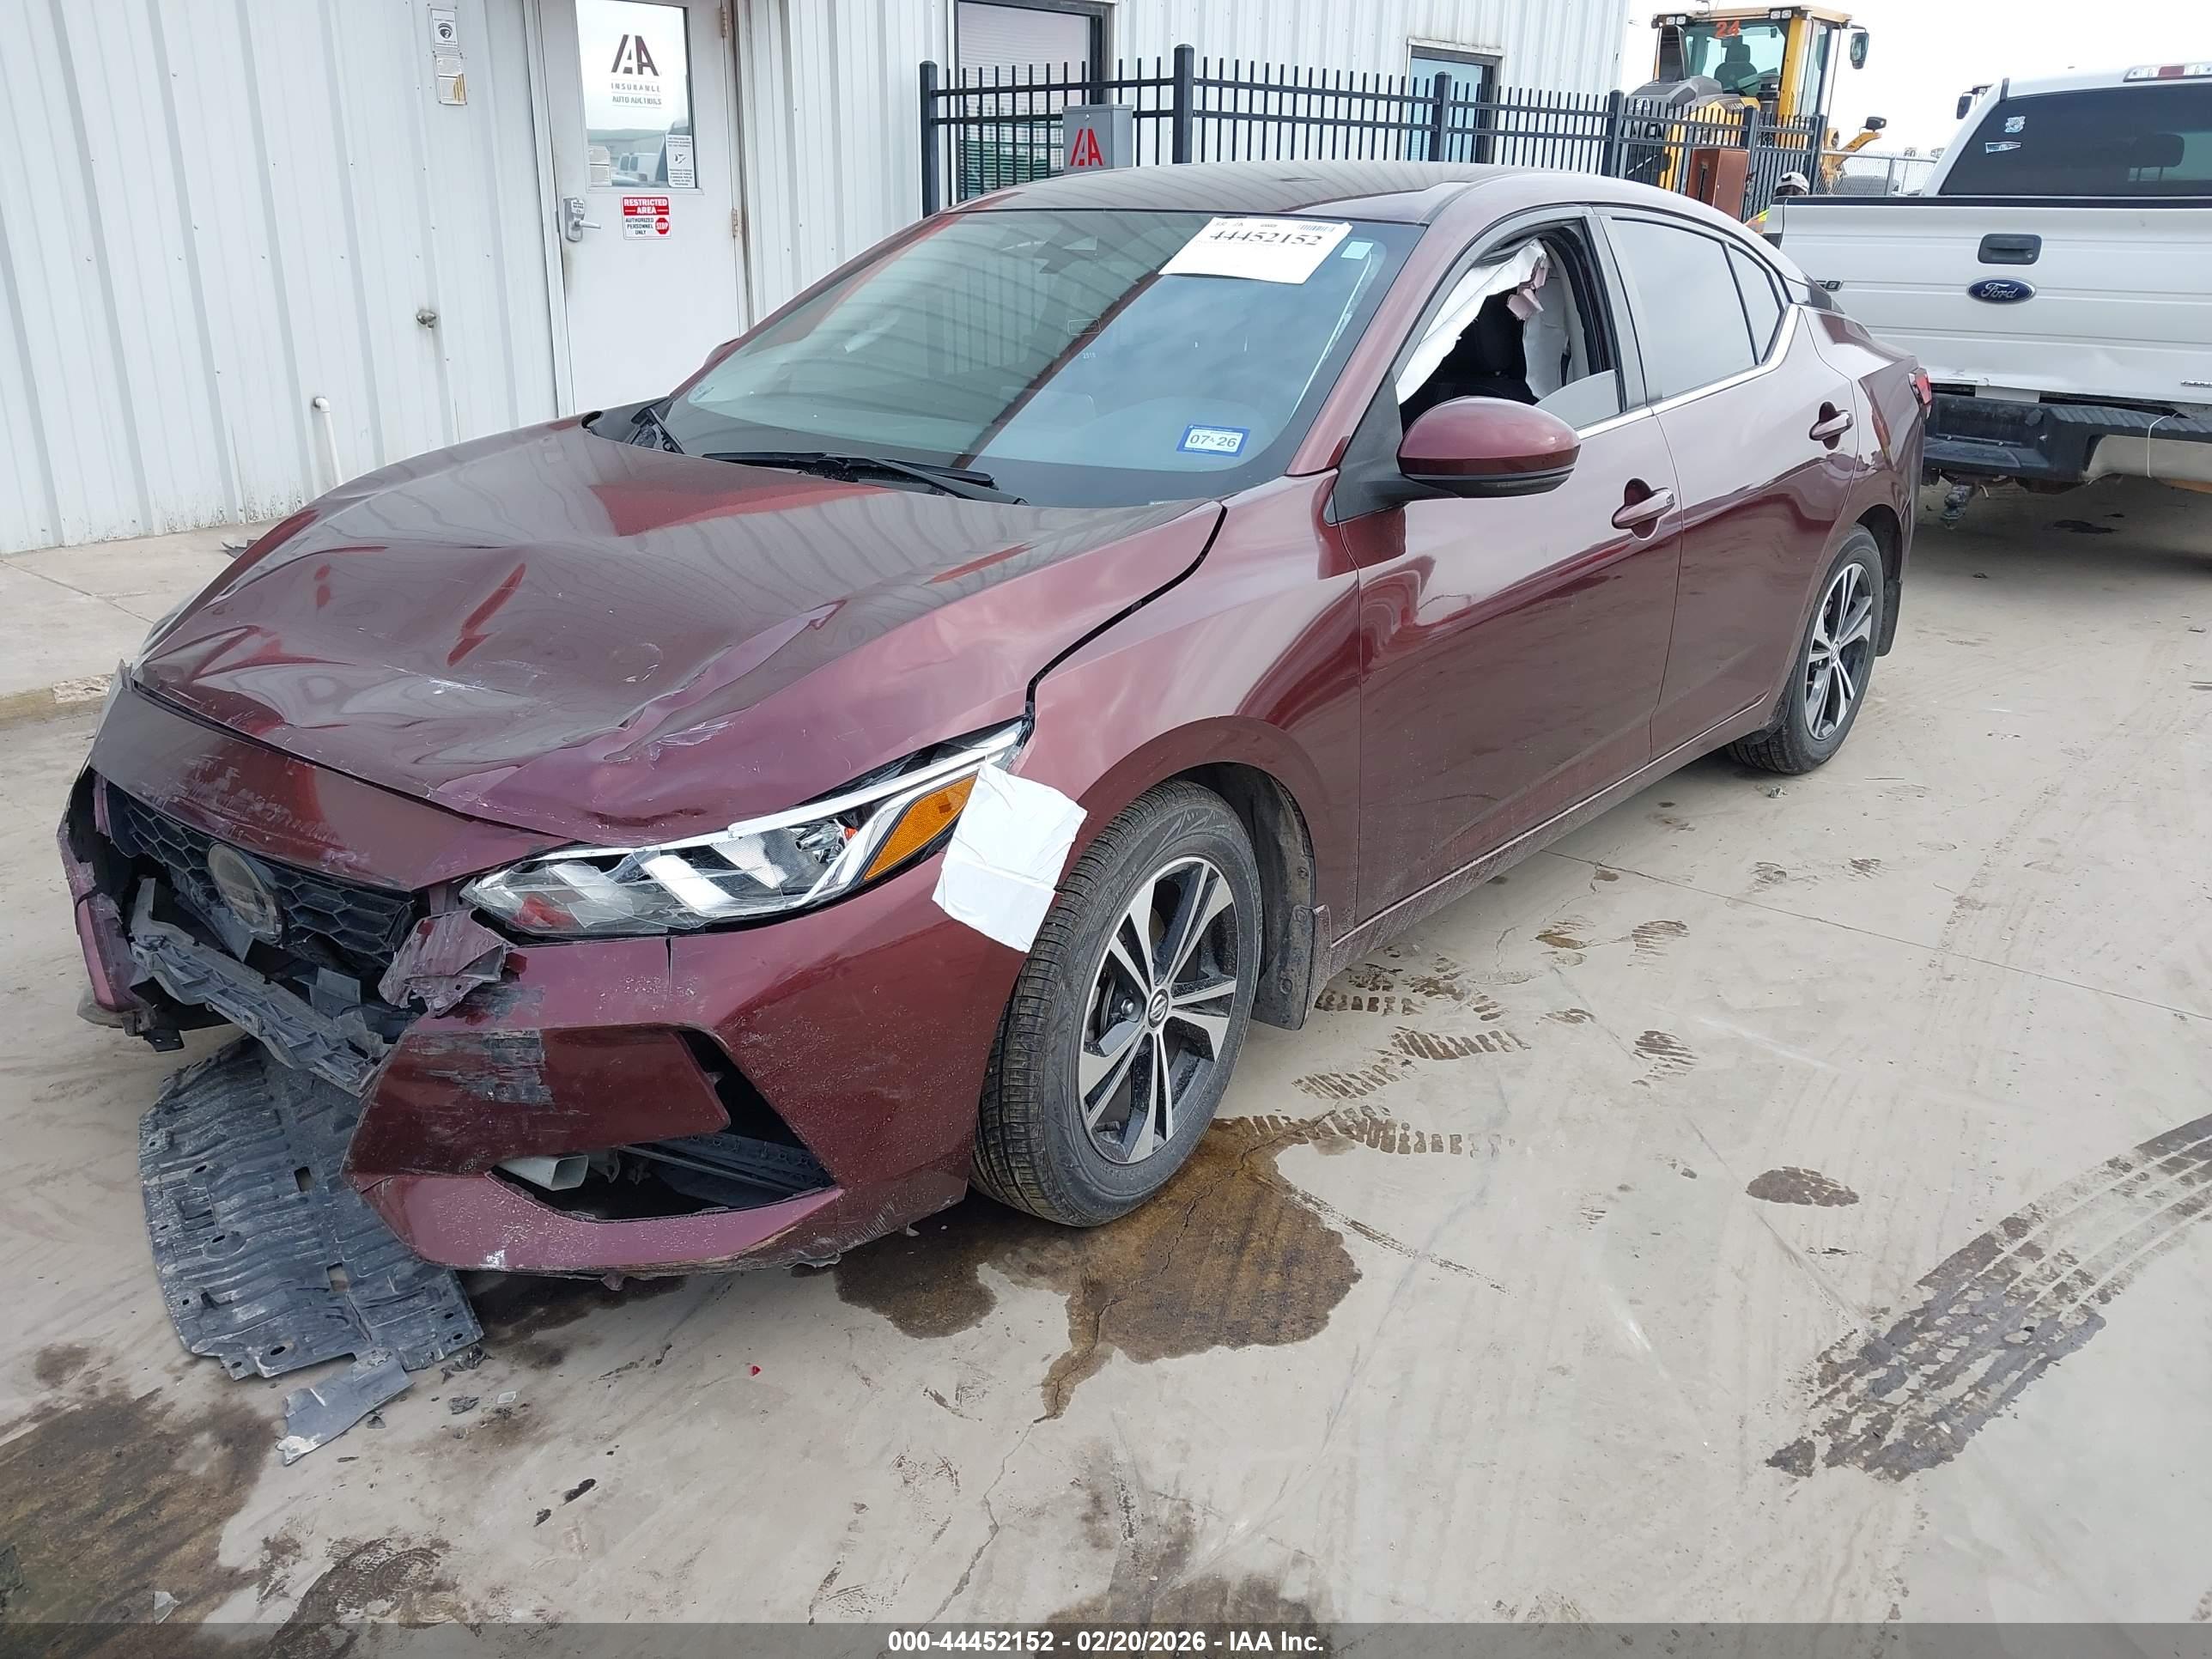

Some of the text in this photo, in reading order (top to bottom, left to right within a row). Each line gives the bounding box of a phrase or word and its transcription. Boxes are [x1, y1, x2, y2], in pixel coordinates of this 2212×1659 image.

[1715, 20, 1740, 39] 24
[623, 198, 669, 207] RESTRICTED
[636, 206, 658, 215] AREA
[1209, 230, 1322, 246] 44452152
[1980, 282, 2020, 298] Ford
[1189, 434, 1237, 447] 07 26
